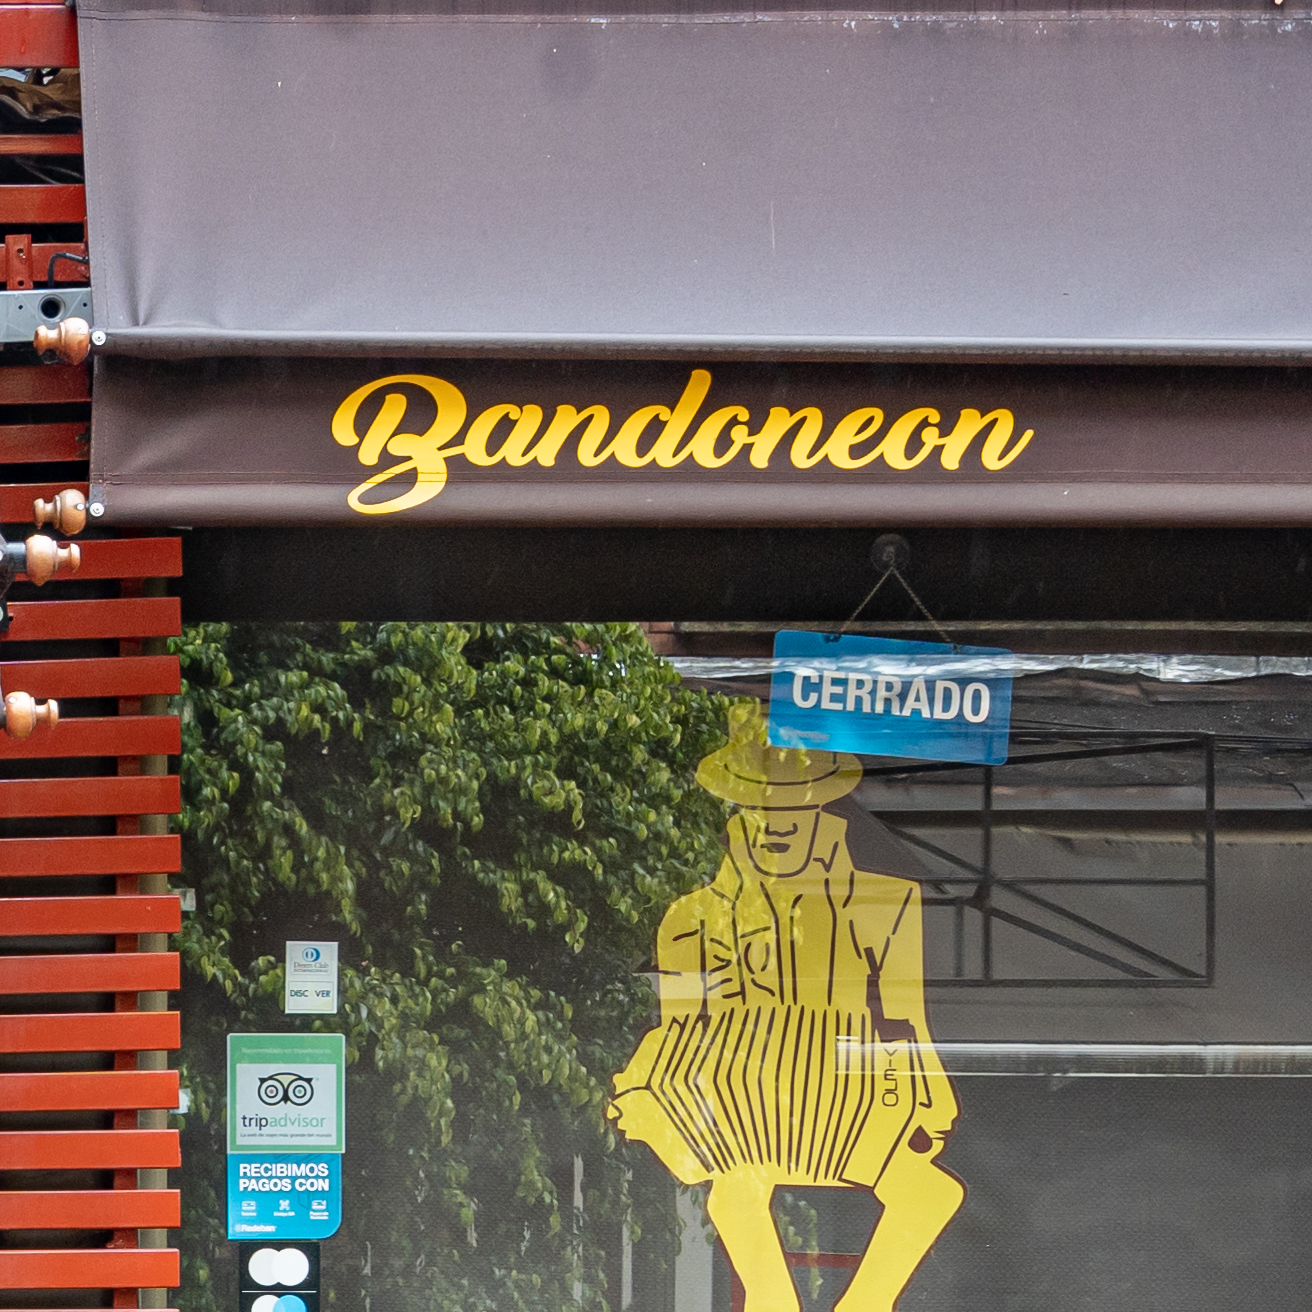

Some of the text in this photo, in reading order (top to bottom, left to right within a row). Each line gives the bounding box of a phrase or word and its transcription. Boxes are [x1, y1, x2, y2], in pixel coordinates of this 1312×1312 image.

[330, 369, 1035, 515] Bandoneon
[792, 667, 991, 723] CERRADO
[290, 989, 331, 998] DISCVER
[882, 1047, 899, 1107] VIEJO
[241, 1113, 326, 1131] tripadvisor
[239, 1163, 329, 1177] RECIBIMOS
[239, 1178, 329, 1192] PAGOS CON
